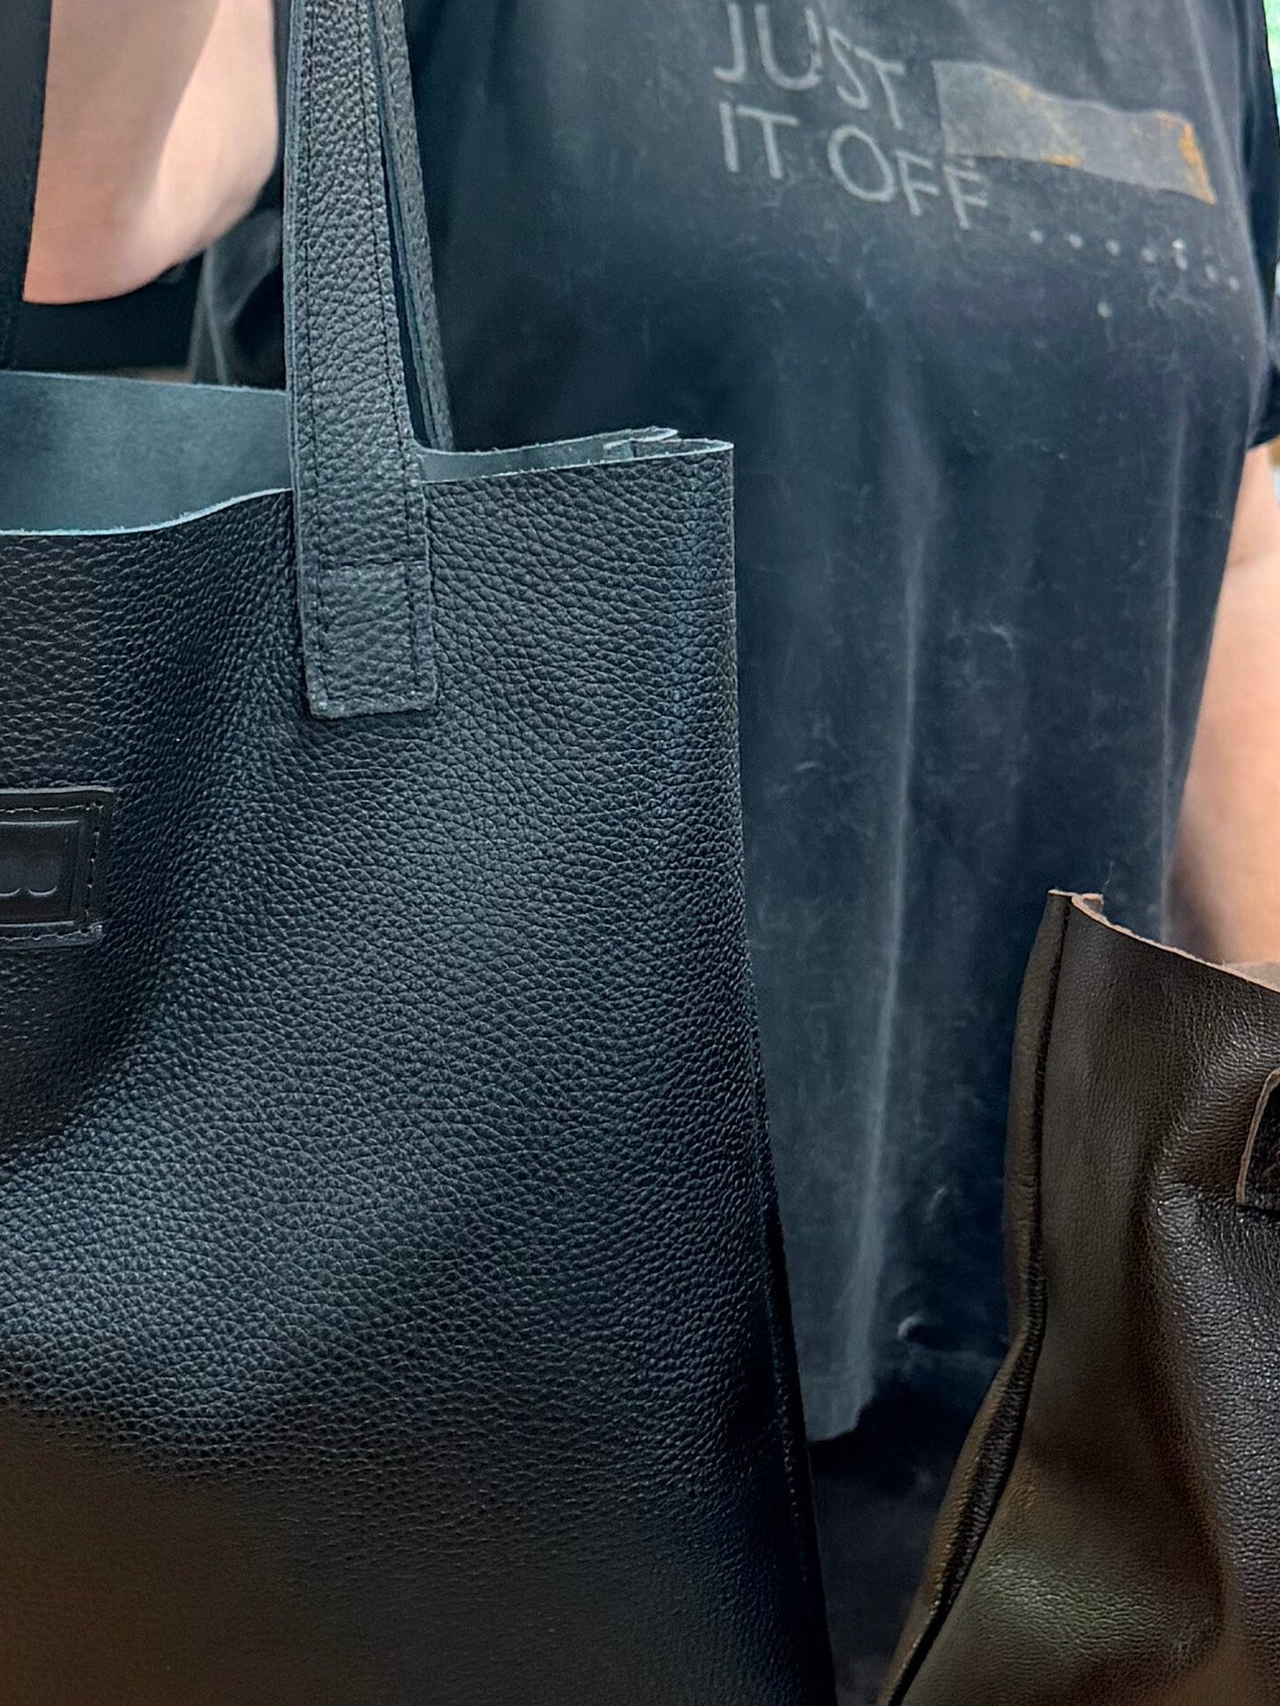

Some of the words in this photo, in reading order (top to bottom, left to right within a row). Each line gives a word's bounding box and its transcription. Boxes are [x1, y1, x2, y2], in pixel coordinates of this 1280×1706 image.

[714, 1, 907, 131] JUST
[718, 100, 800, 181] IT
[826, 123, 988, 230] OFF
